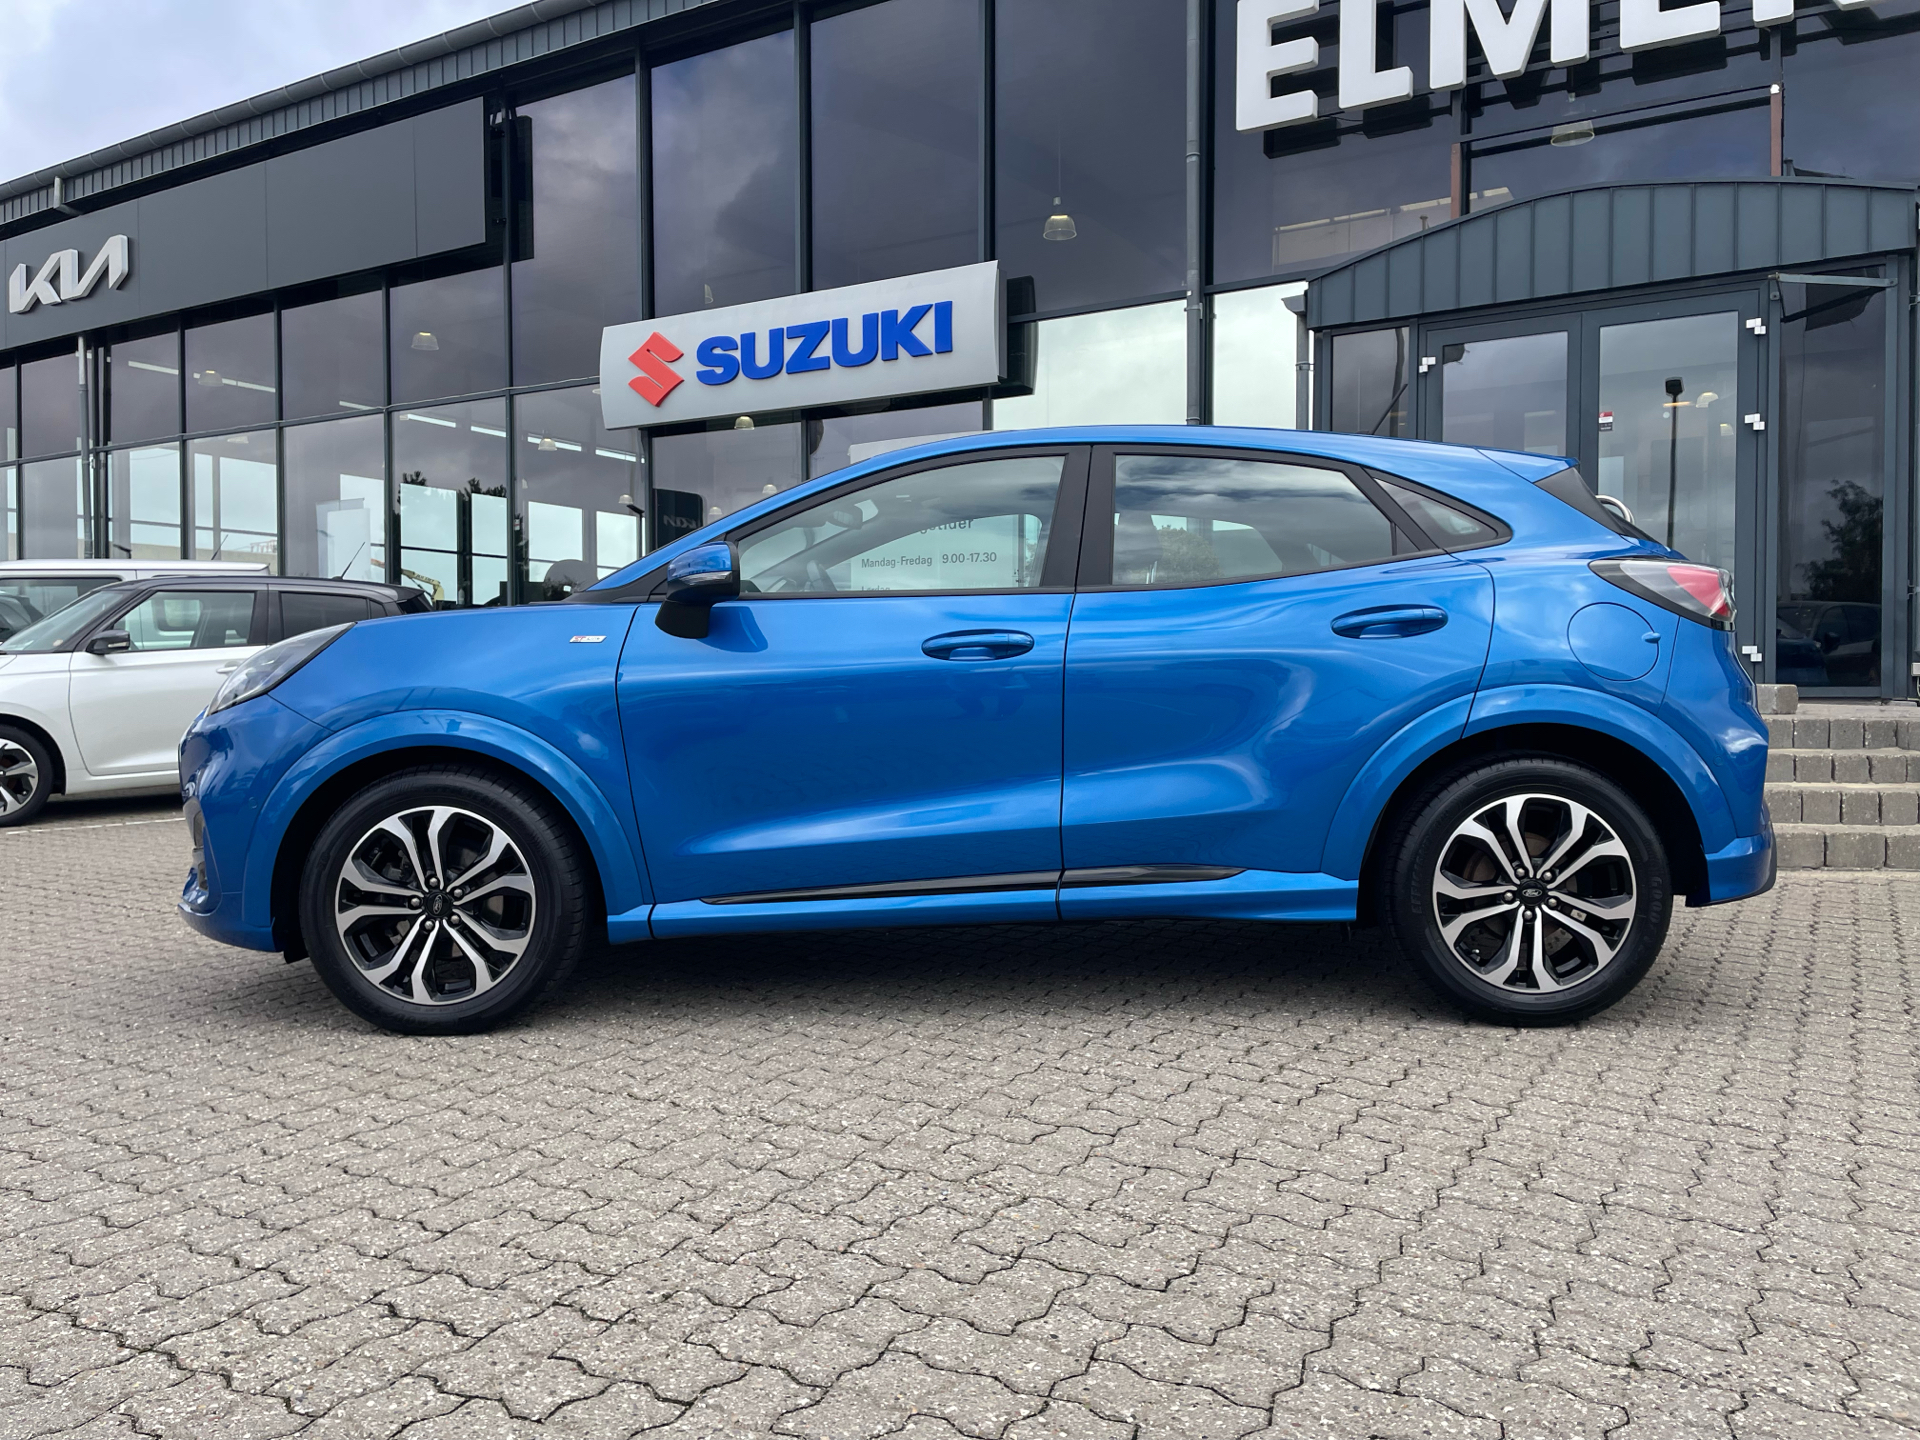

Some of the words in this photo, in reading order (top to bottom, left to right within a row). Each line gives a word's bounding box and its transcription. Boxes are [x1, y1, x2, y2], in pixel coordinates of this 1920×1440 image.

[1236, 0, 1883, 132] ELM
[9, 233, 129, 313] KIA
[696, 300, 953, 386] SUZUKI
